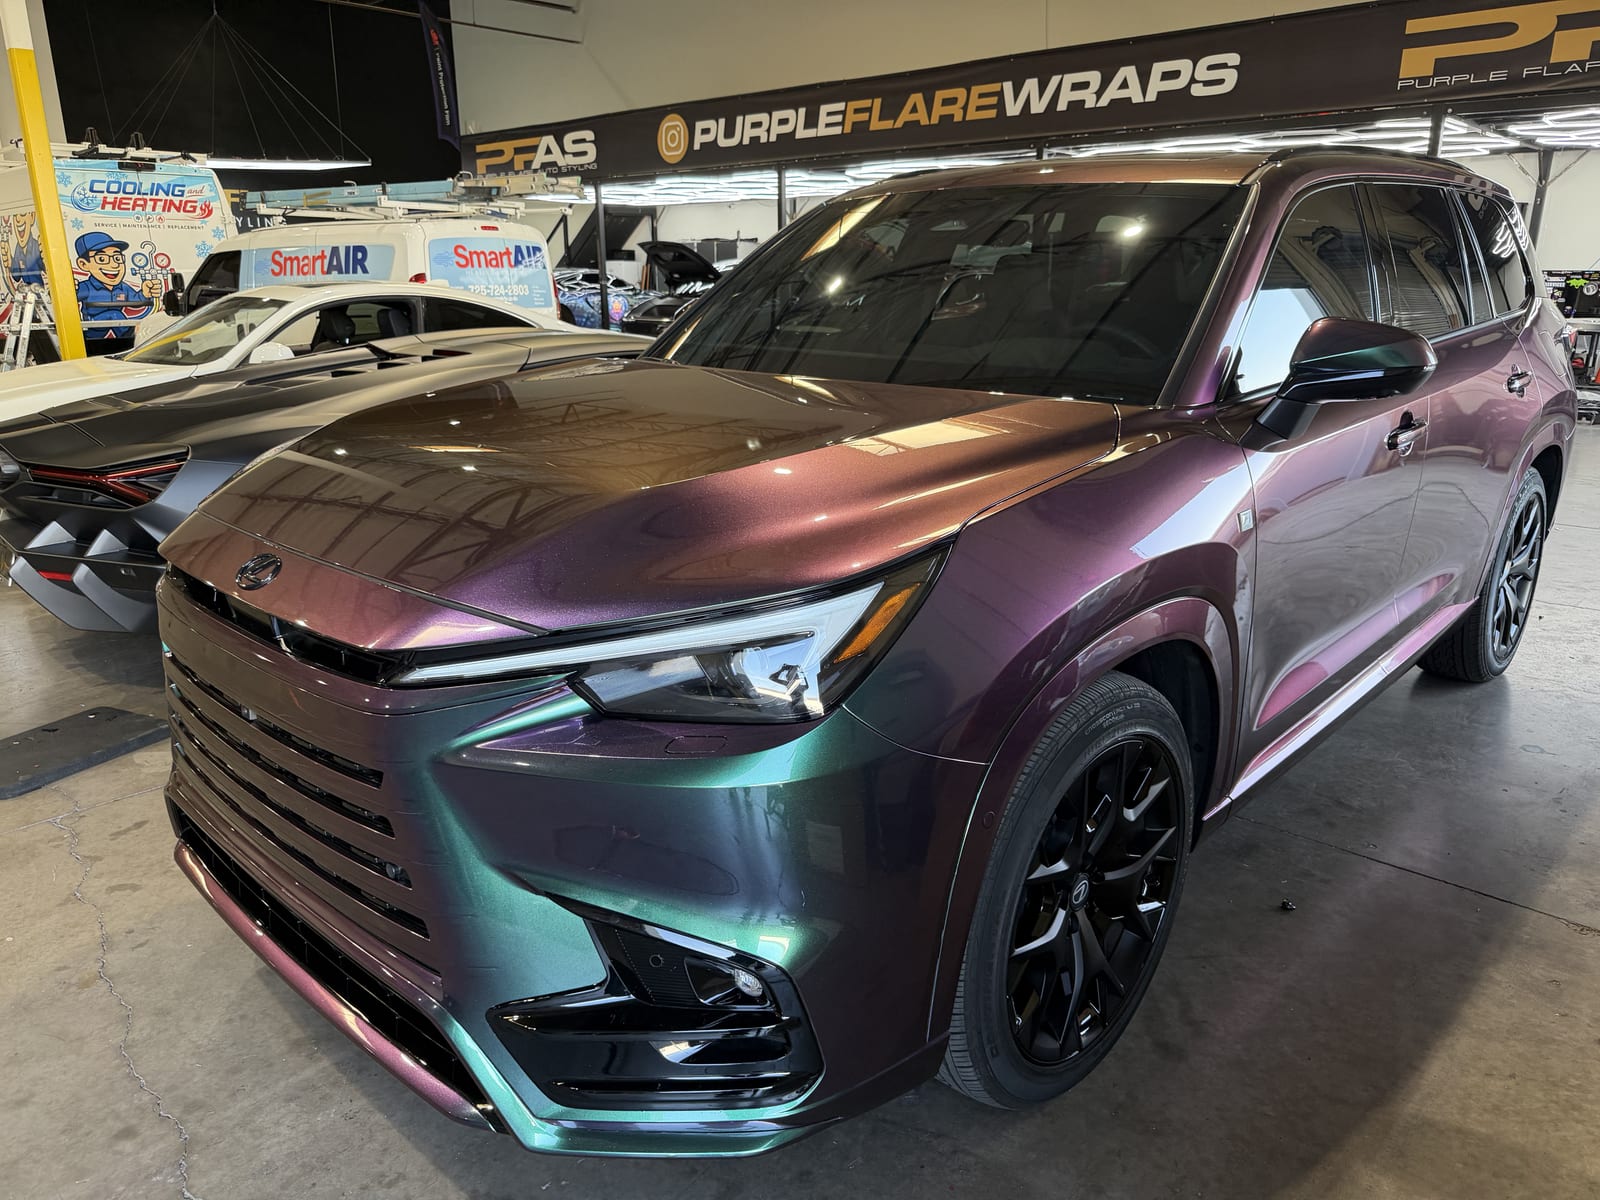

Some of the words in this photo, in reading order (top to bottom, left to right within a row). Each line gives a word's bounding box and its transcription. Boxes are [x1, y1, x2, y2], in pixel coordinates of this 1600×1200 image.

[1397, 70, 1508, 91] PURPLE
[694, 52, 1240, 150] PURPLEFLAREWRAPS
[475, 129, 597, 174] PFAS
[561, 162, 598, 173] STYLING
[89, 179, 186, 198] COOLING
[186, 185, 206, 195] and
[100, 196, 198, 213] HEATING
[270, 245, 369, 277] SmartAIR
[468, 284, 530, 297] 725-724-2803
